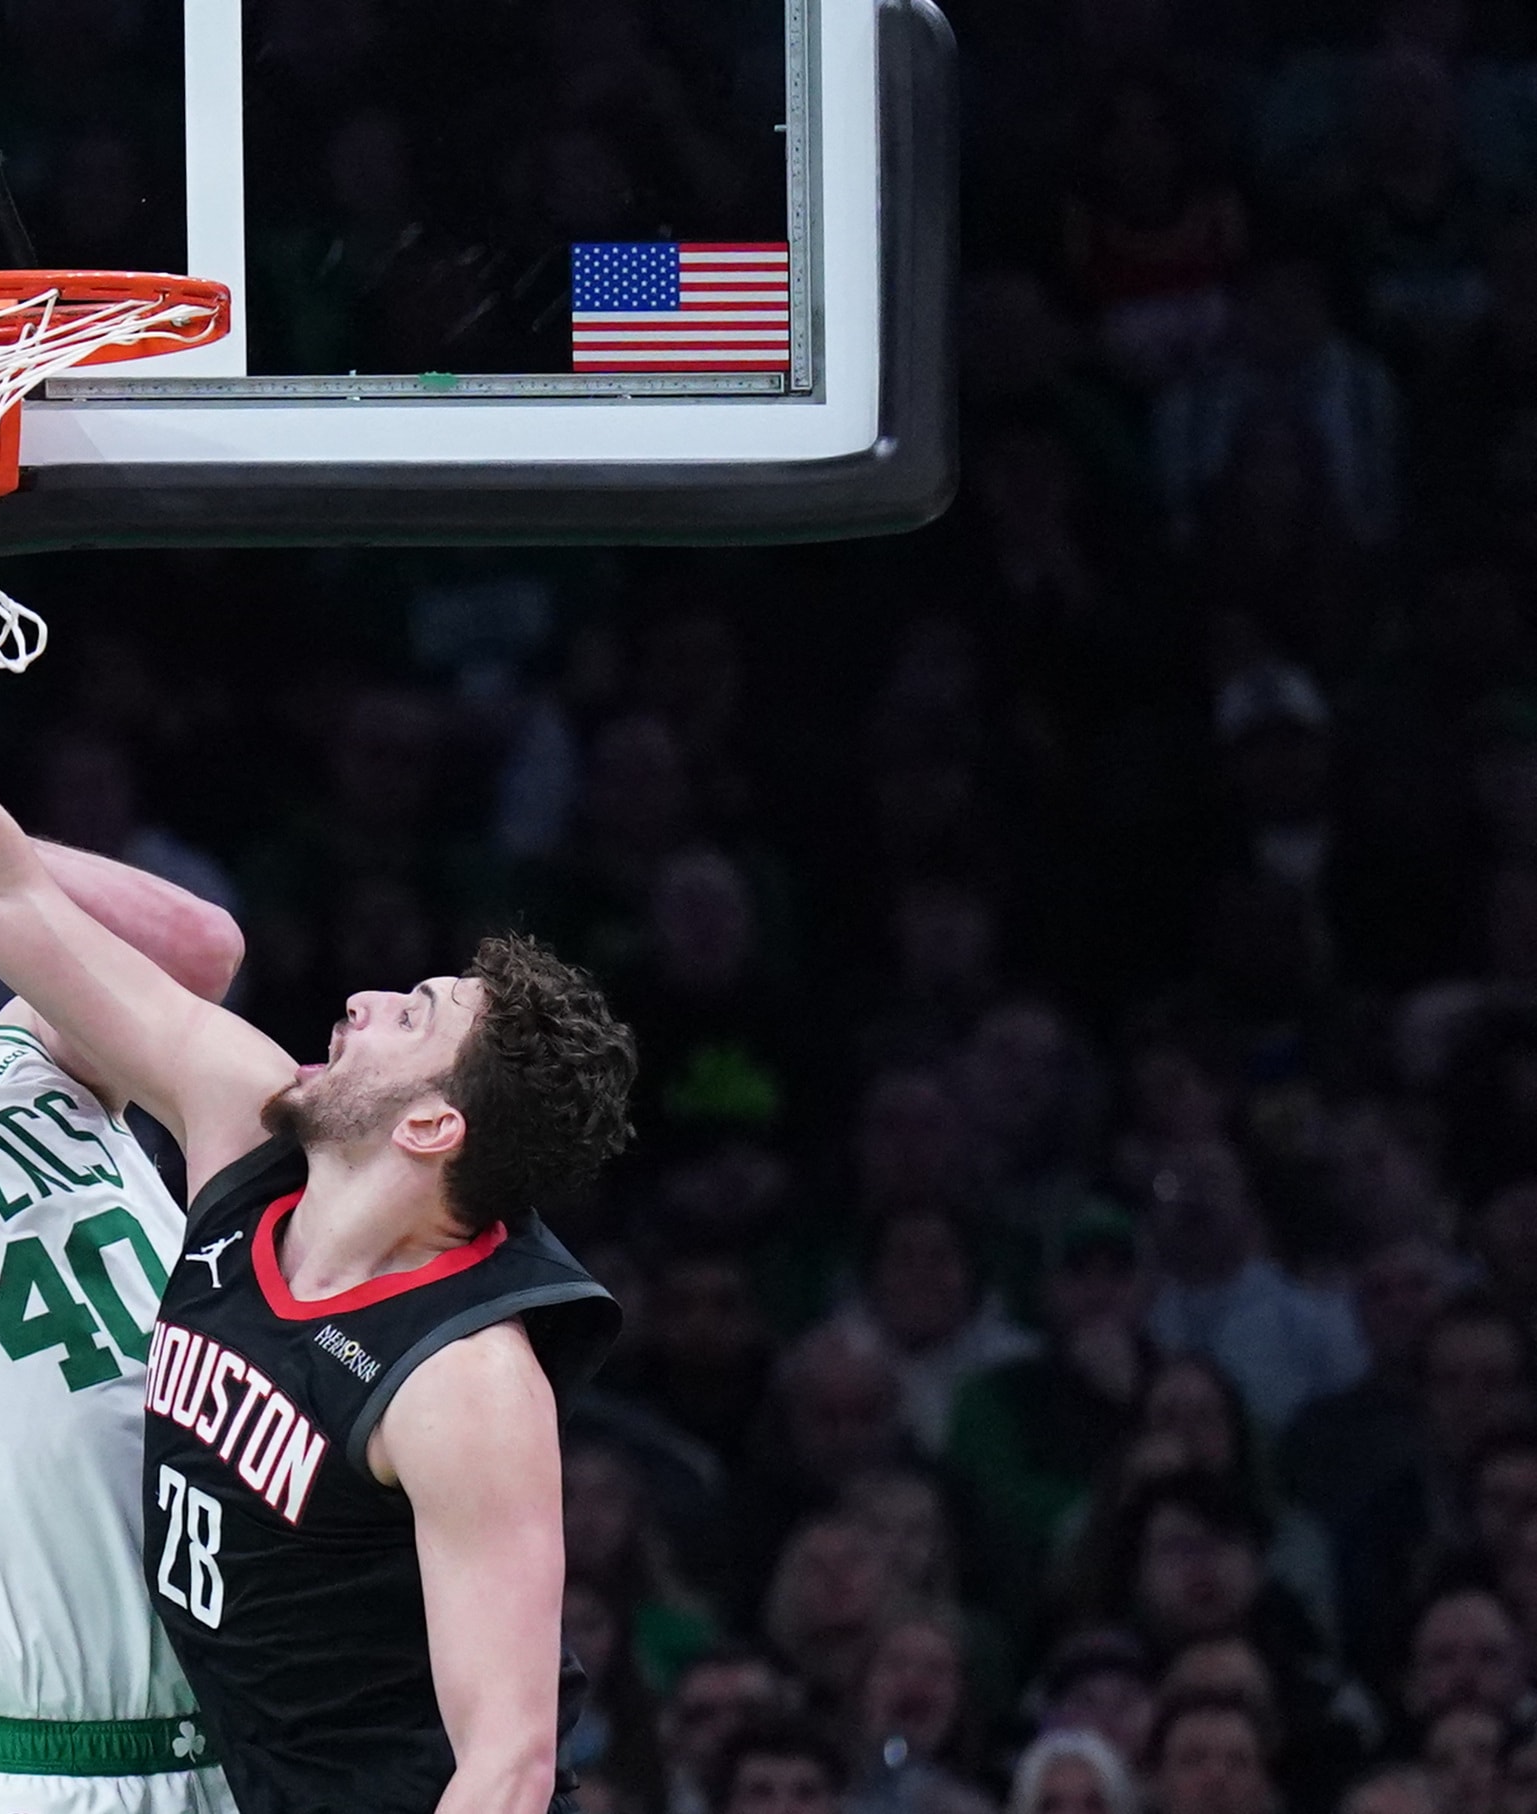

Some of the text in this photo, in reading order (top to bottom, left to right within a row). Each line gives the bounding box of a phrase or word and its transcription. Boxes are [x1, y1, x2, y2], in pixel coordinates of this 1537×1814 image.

[144, 1320, 331, 1528] HOUSTON
[321, 1324, 381, 1374] MEMORIAL
[157, 1463, 224, 1629] 28
